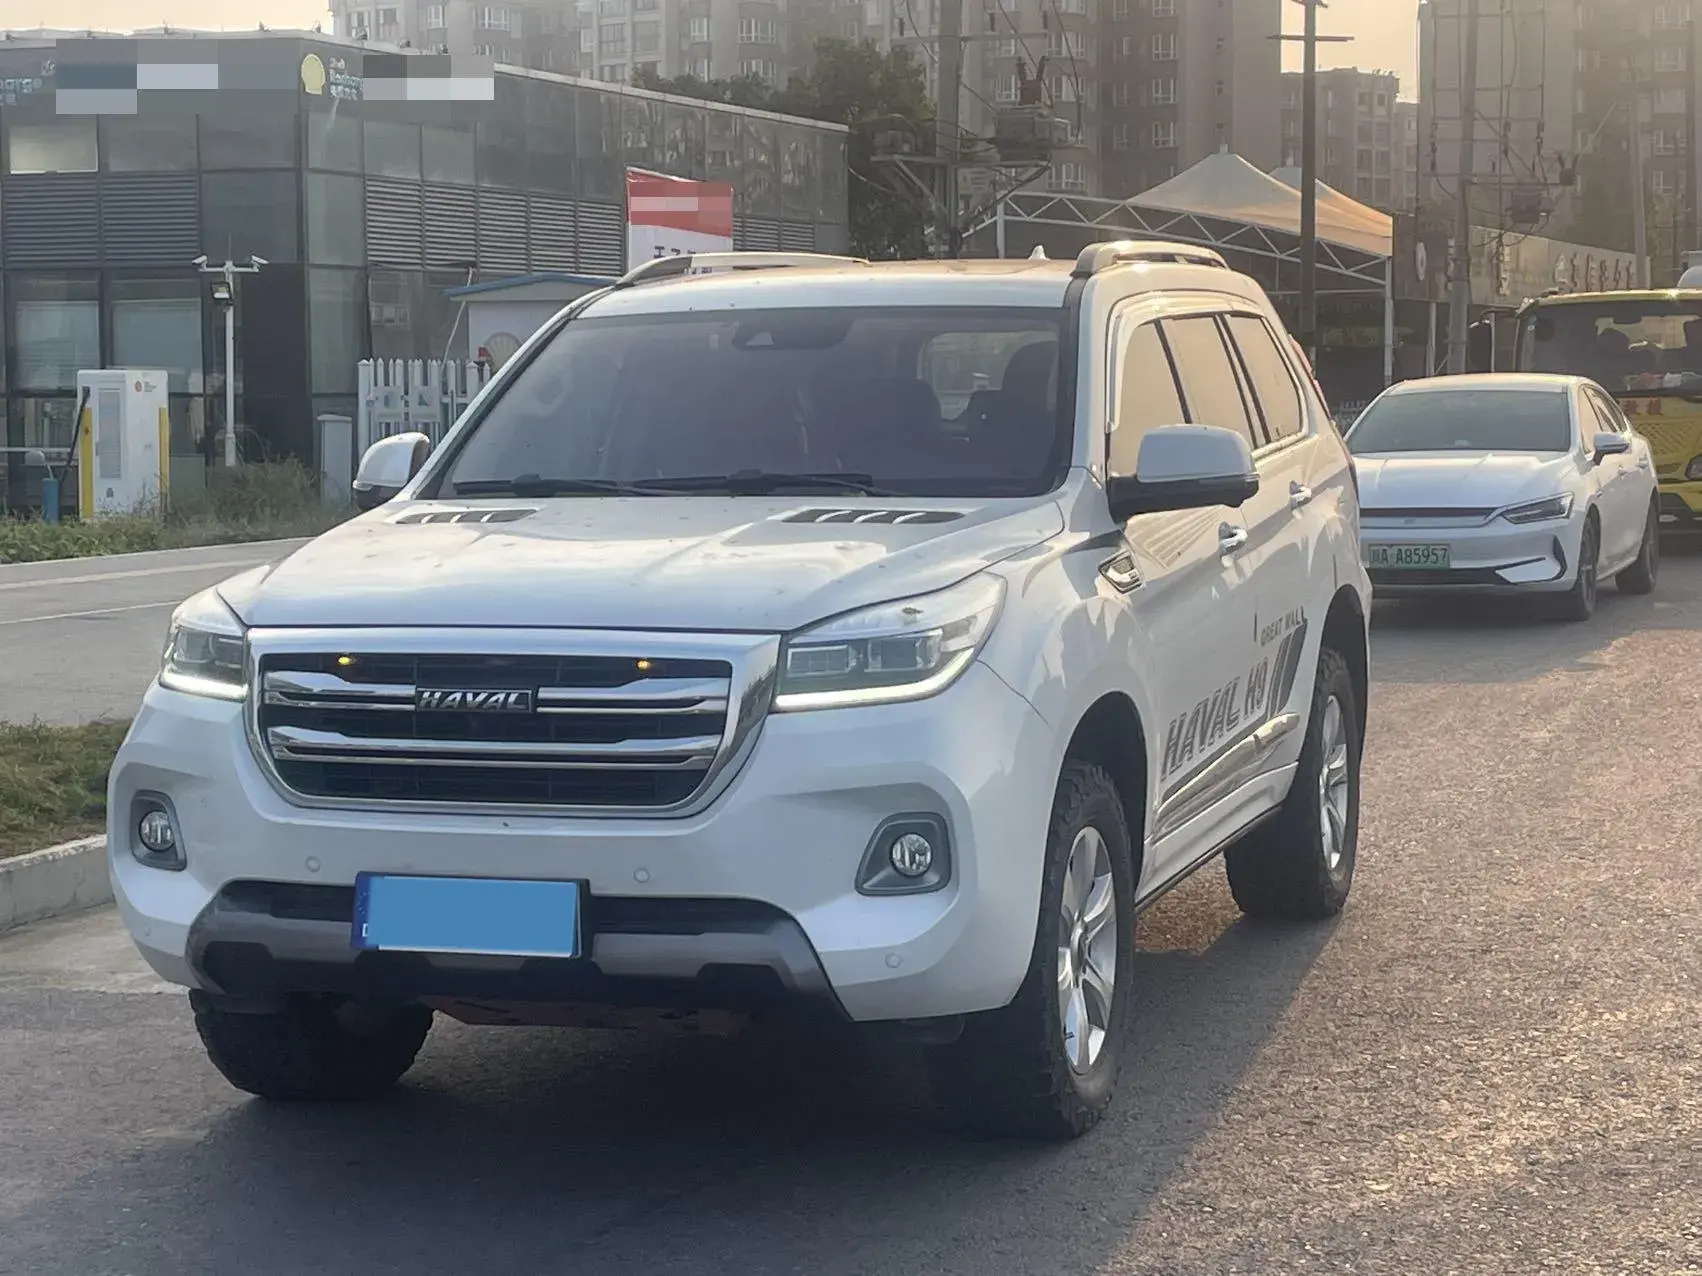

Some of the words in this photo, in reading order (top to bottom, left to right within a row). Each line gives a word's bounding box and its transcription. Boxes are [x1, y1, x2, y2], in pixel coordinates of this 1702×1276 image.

[1261, 617, 1284, 646] GREAT
[1285, 605, 1308, 630] WALL
[420, 691, 527, 709] HAVAL
[1160, 675, 1241, 783] HAVAL
